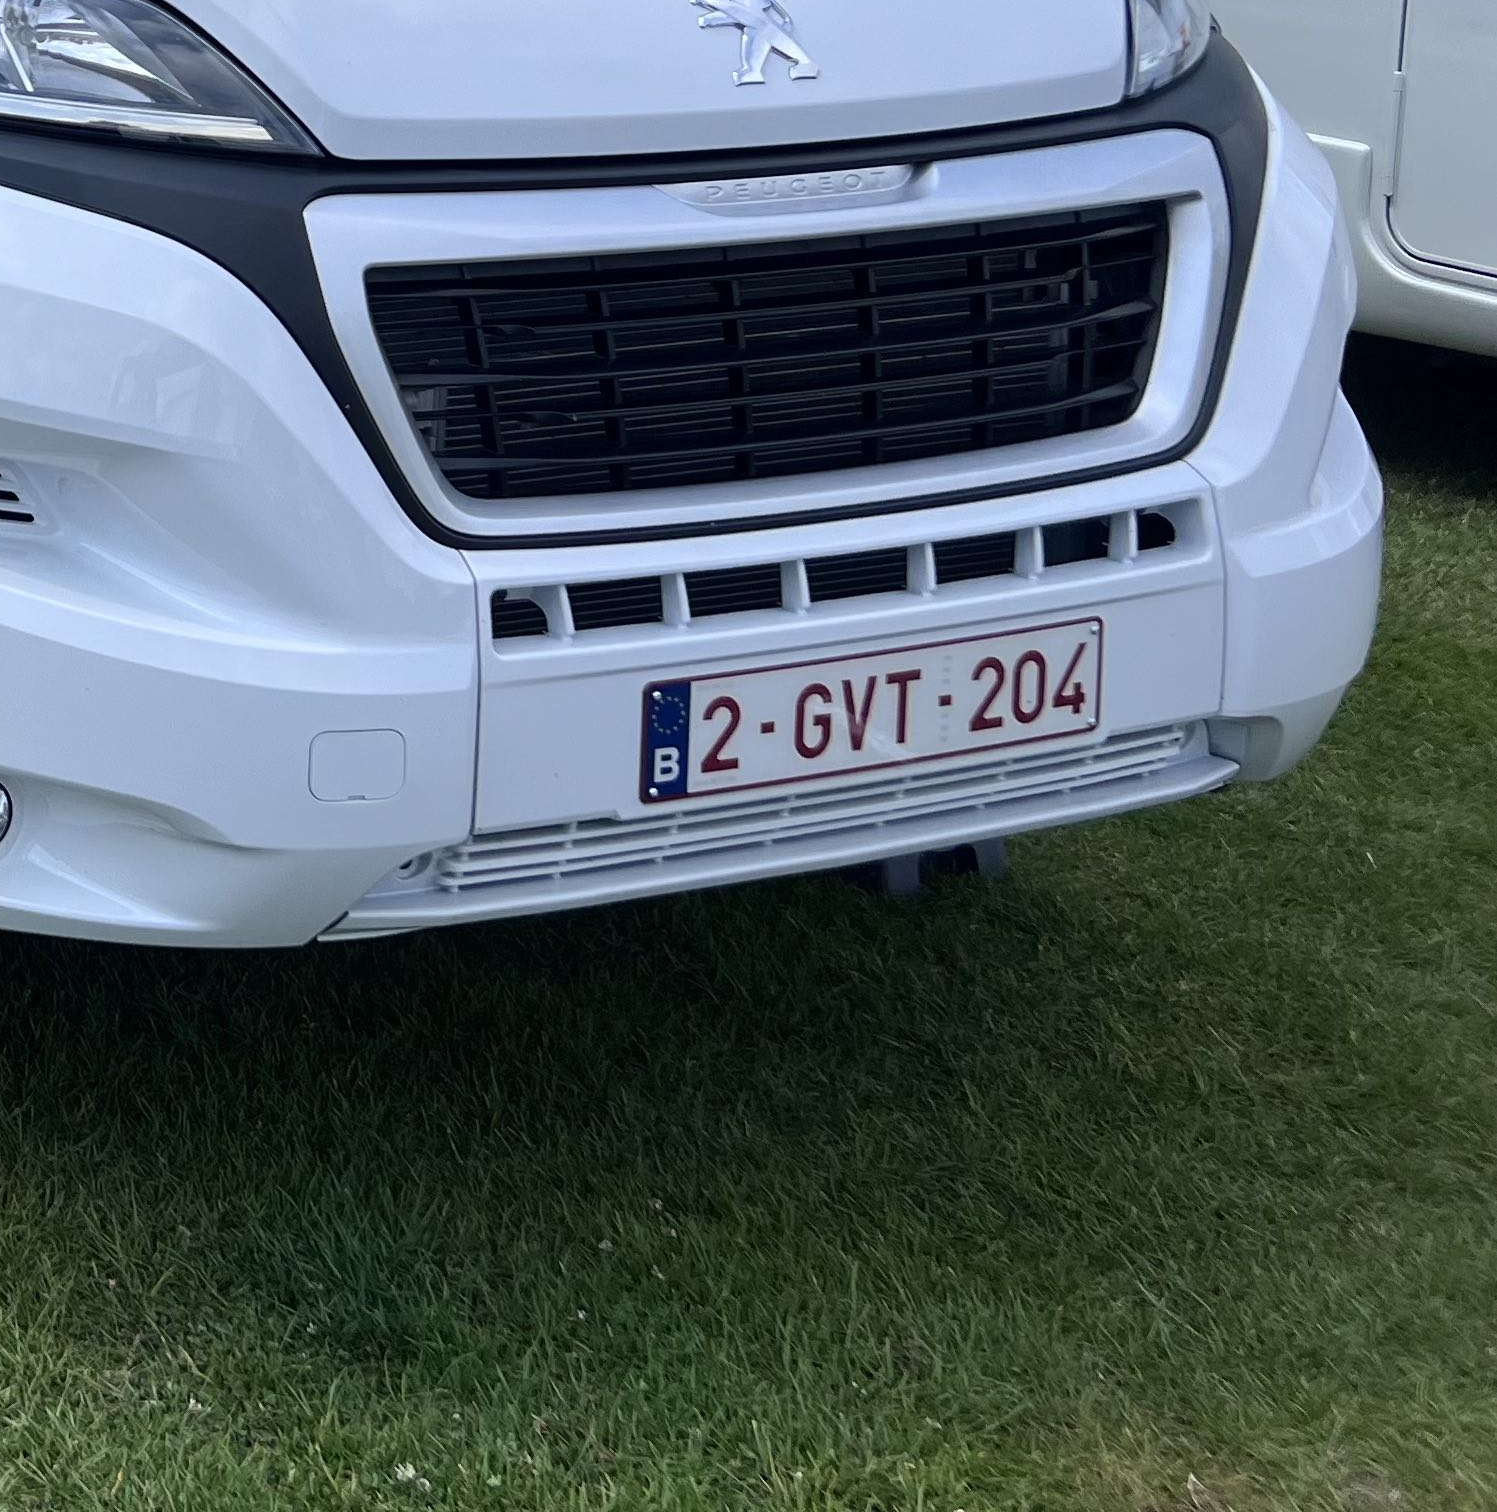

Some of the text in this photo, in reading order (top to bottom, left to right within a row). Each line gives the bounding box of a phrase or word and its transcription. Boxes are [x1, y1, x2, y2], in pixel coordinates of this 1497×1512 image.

[705, 170, 886, 201] PEUGEOT
[700, 641, 1087, 774] 2-GVT-204
[653, 746, 681, 783] B
